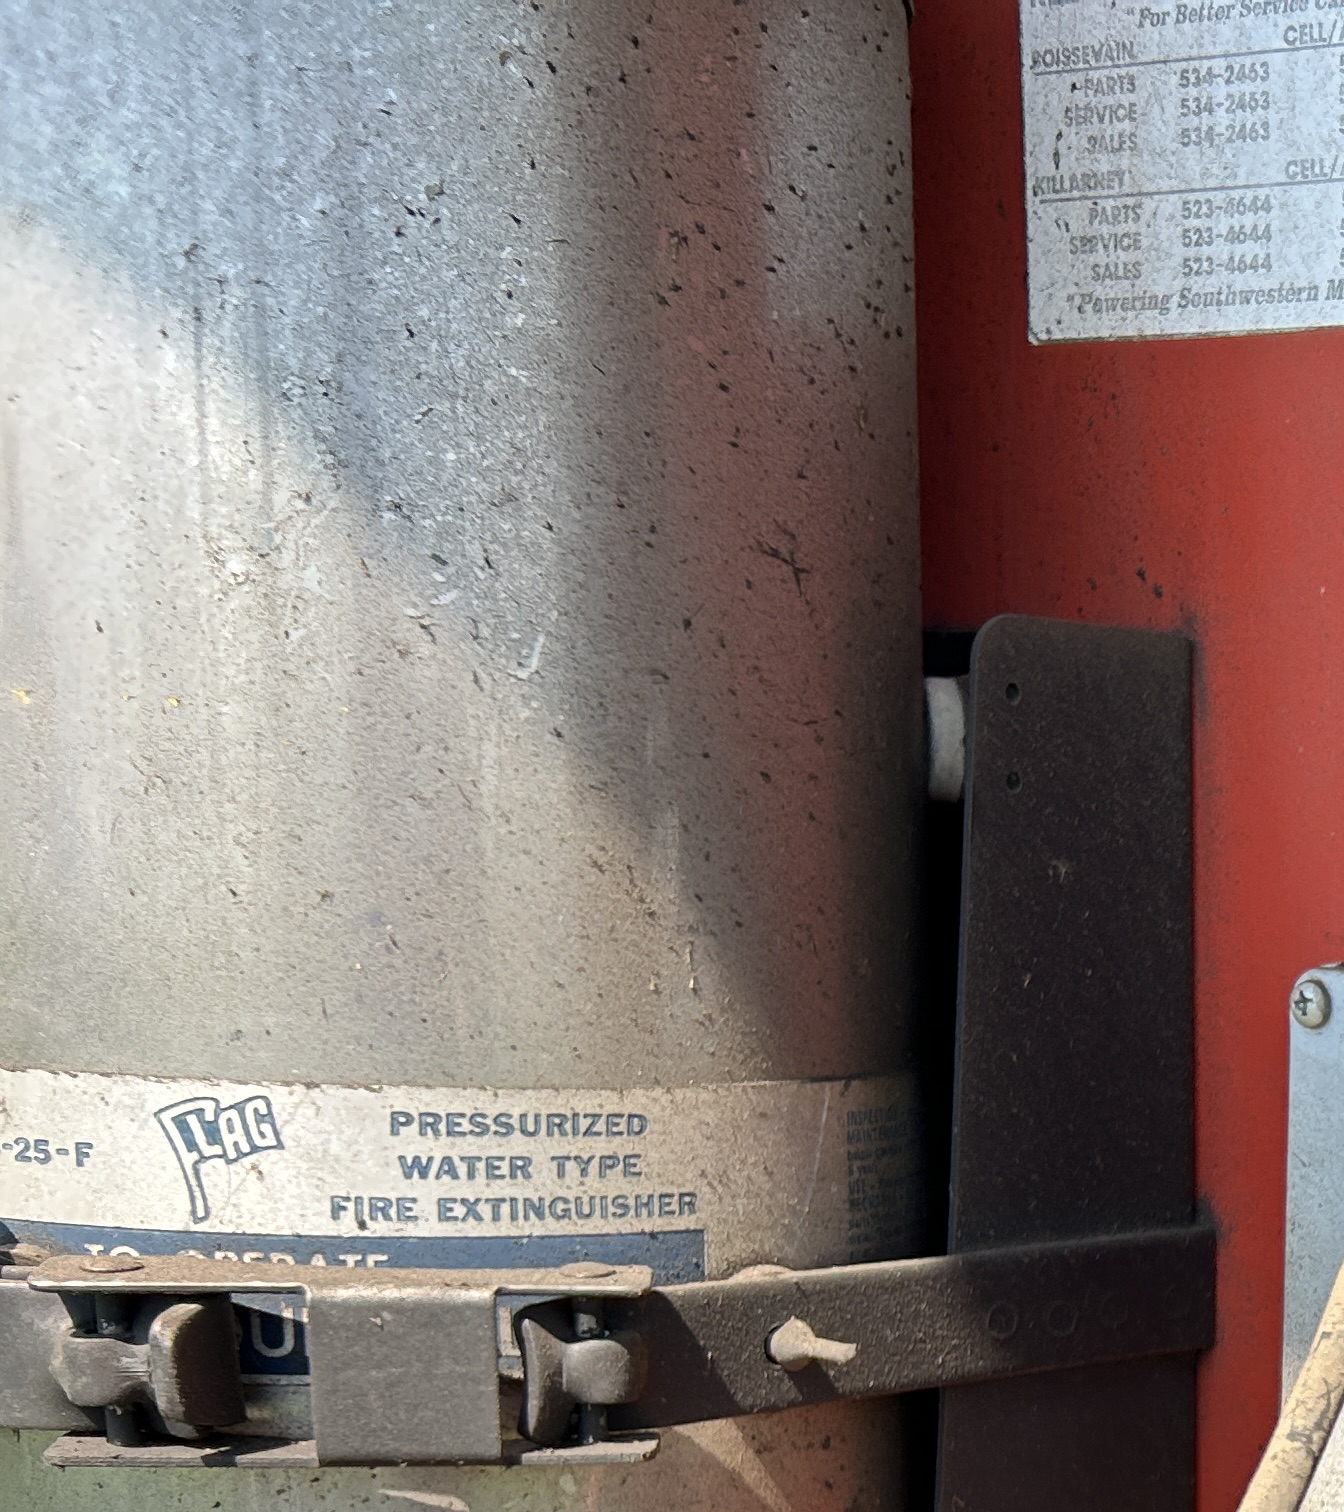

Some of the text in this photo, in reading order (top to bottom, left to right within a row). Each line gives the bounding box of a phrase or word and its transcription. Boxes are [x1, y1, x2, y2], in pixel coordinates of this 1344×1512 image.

[1175, 3, 1235, 25] Better
[1084, 74, 1136, 97] PARTS
[1064, 102, 1137, 127] SERVICE
[1179, 121, 1270, 147] 534-2463
[1089, 203, 1143, 226] PARTS
[1069, 232, 1142, 255] SERVICE
[1091, 260, 1143, 282] SALES
[1181, 252, 1273, 278] 523-4644
[1178, 282, 1319, 308] Southwestern
[389, 1111, 648, 1138] PRESSURIZED
[154, 1095, 285, 1225] FLAG
[398, 1153, 643, 1180] WATER TYPE
[330, 1191, 698, 1223] FIRE EXTINGUISHER
